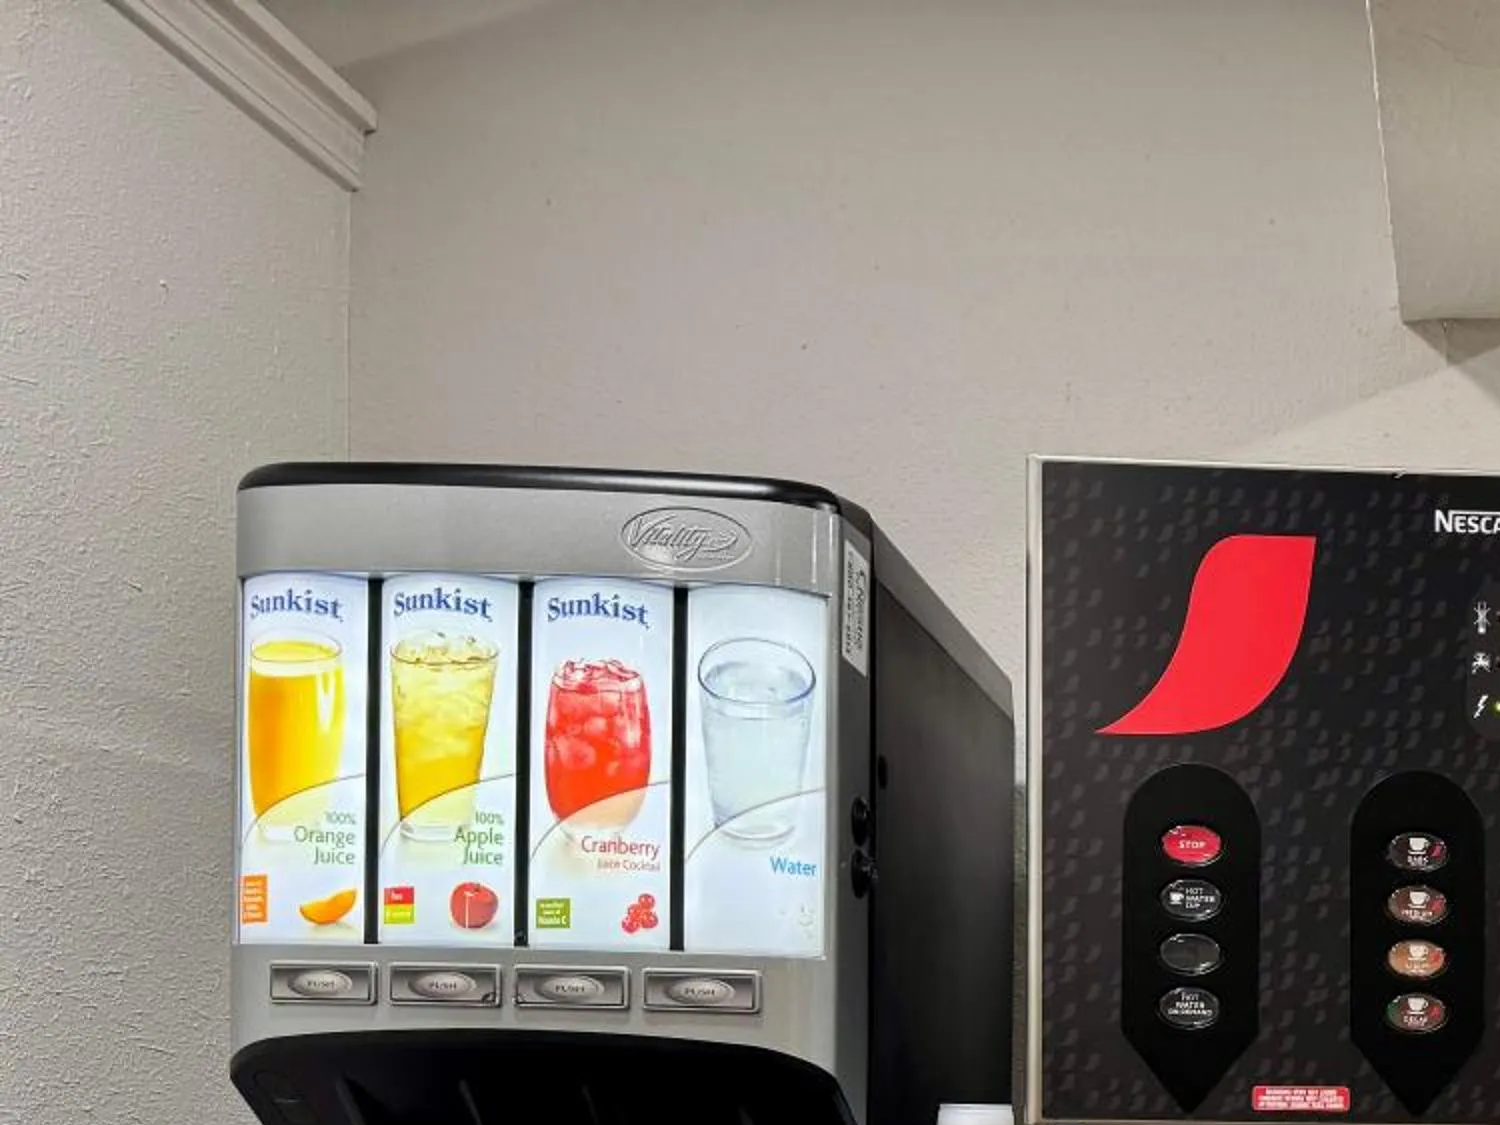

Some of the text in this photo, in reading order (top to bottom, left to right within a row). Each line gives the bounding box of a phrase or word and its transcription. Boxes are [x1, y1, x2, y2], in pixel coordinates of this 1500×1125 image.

[250, 588, 343, 621] Sunkist
[393, 587, 493, 622] Sunkist
[547, 593, 649, 628] Sunkist
[474, 811, 505, 825] 100%
[294, 826, 356, 849] Orange
[454, 827, 504, 849] Apple
[581, 835, 660, 860] Cranberry
[1178, 840, 1207, 849] STOP
[314, 848, 355, 865] Juice
[463, 848, 503, 865] Juice
[769, 856, 816, 877] Water
